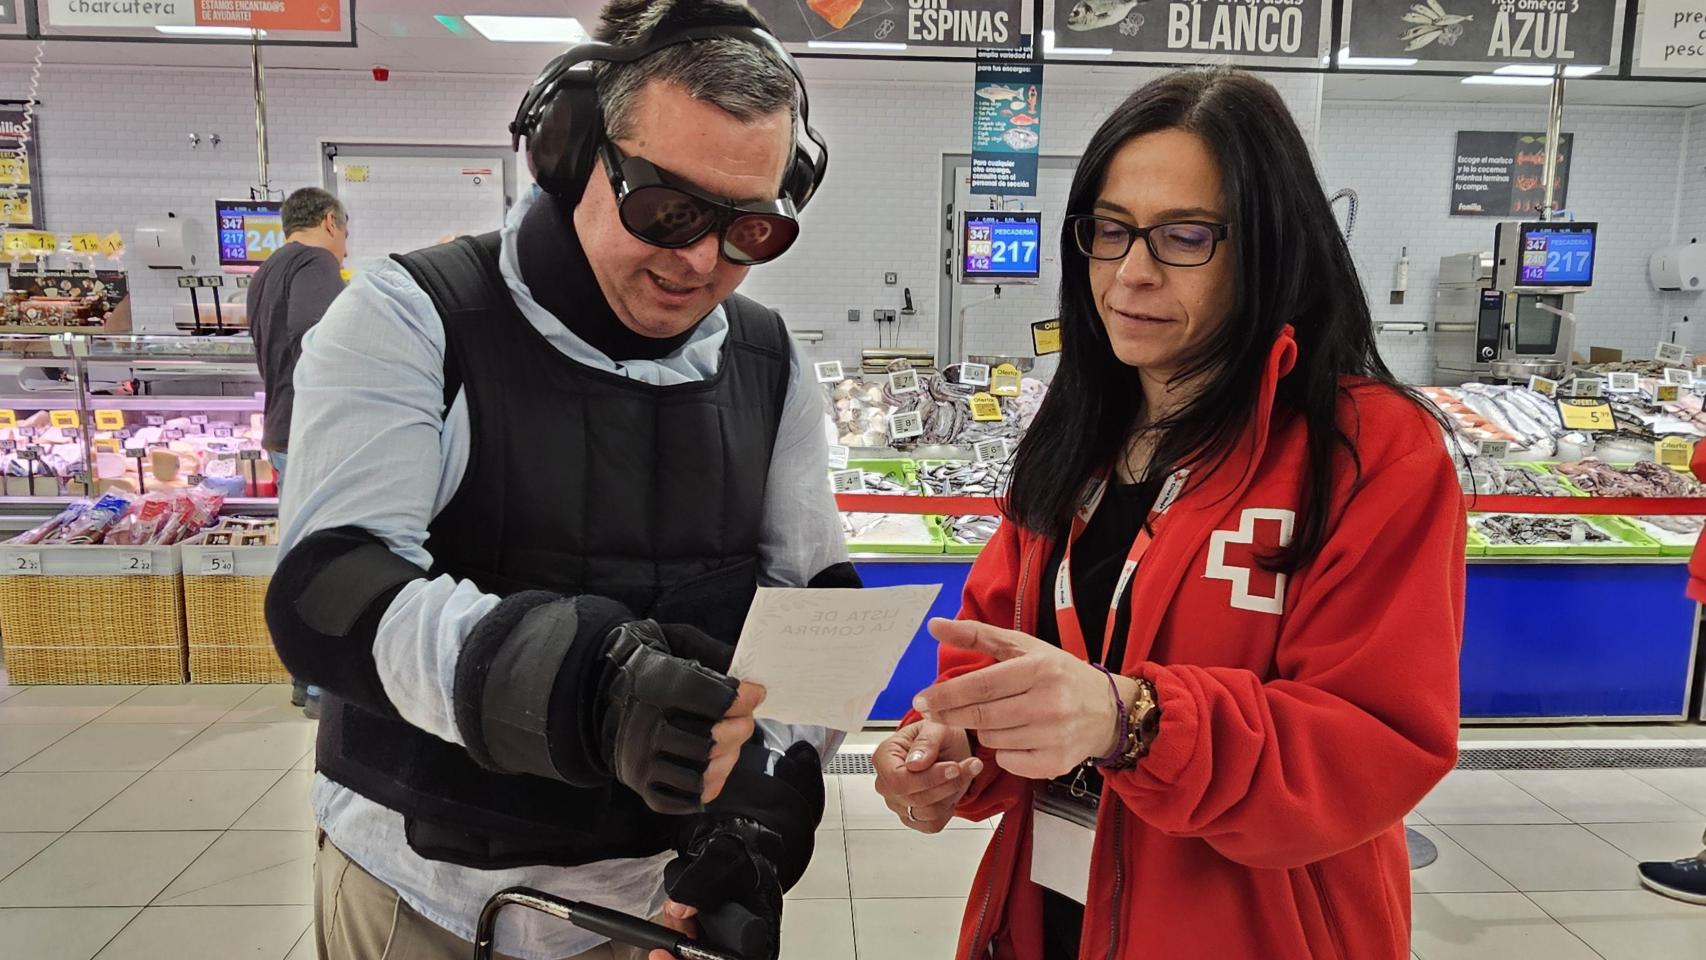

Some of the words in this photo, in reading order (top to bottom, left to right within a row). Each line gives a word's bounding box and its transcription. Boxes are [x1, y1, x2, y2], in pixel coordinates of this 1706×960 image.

[1518, 0, 1567, 13] omega
[908, 9, 1009, 43] ESPINAS
[1673, 12, 1706, 29] pre
[1168, 3, 1303, 53] BLANCO
[1487, 11, 1575, 58] AZUL
[973, 158, 987, 166] Para
[987, 159, 1015, 168] cualquier
[1457, 155, 1481, 165] Escoge
[222, 218, 243, 229] 347
[223, 233, 243, 244] 217
[970, 229, 990, 241] 347
[970, 244, 990, 254] 240
[1526, 240, 1546, 251] 347
[224, 247, 246, 259] 142
[991, 241, 1036, 264] 217
[1526, 254, 1544, 263] 240
[969, 259, 989, 270] 142
[1546, 251, 1591, 273] 217
[1525, 268, 1544, 280] 142
[997, 369, 1019, 377] Oferta
